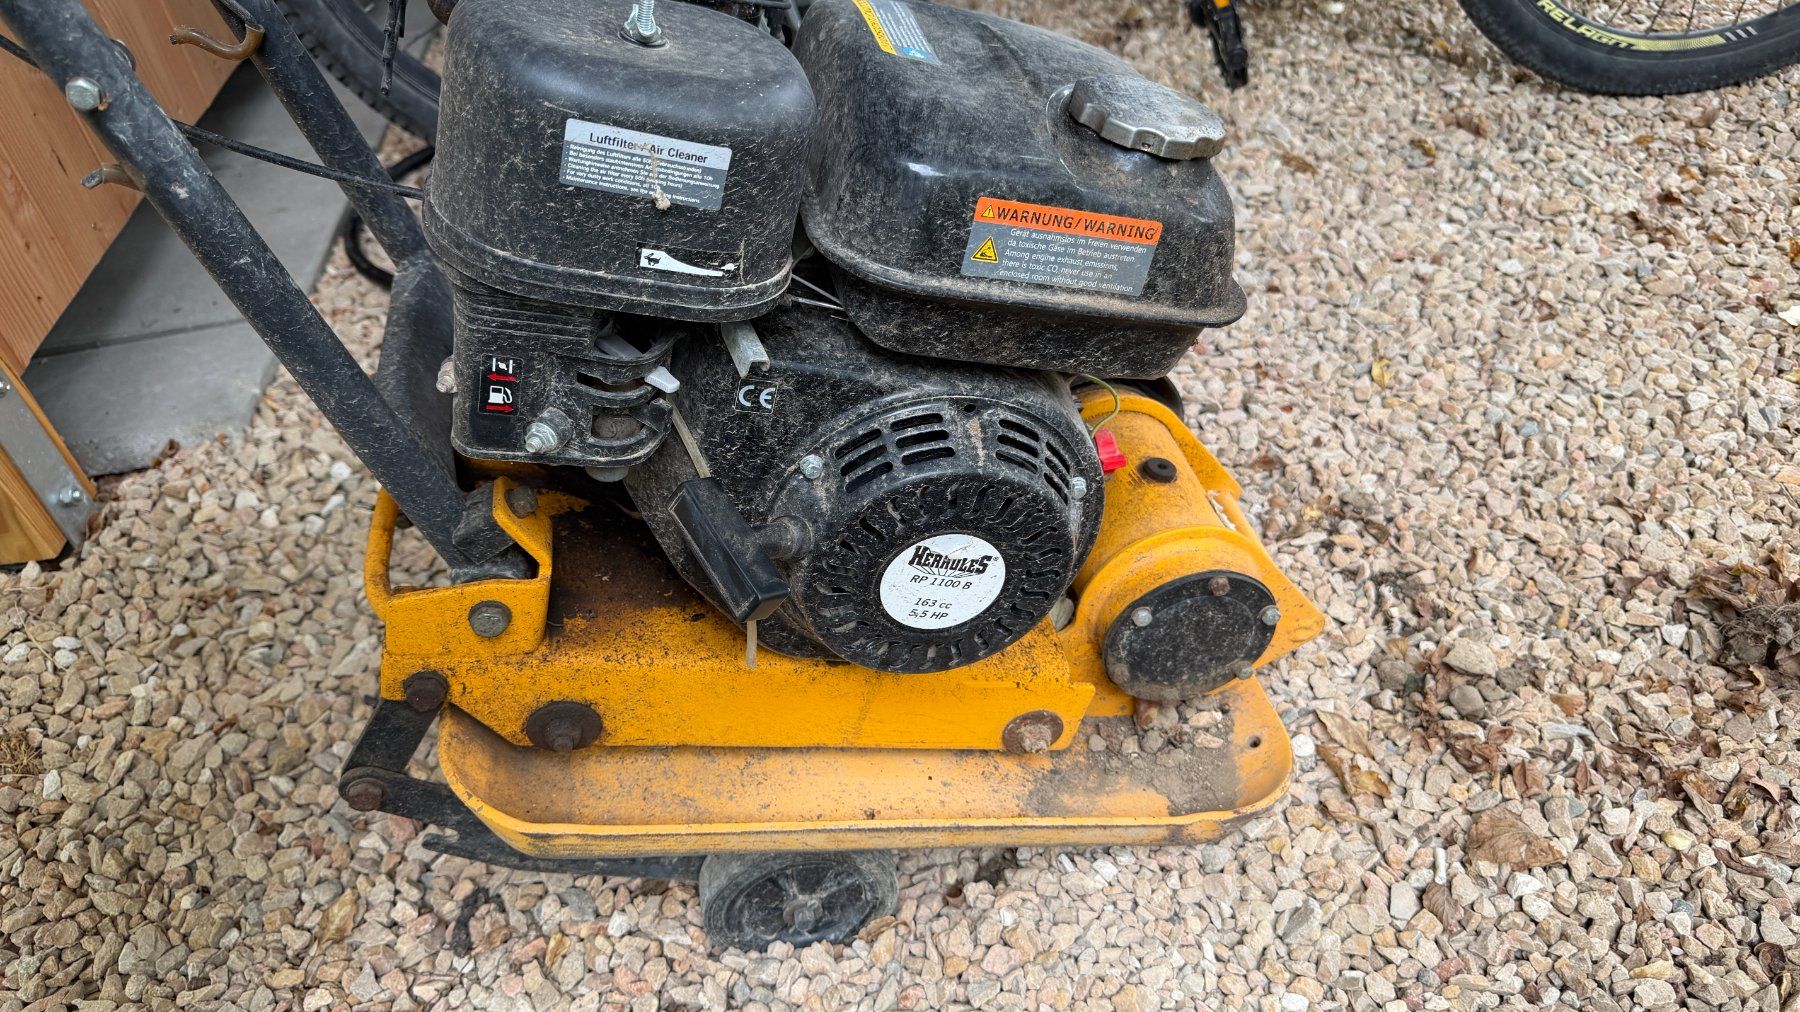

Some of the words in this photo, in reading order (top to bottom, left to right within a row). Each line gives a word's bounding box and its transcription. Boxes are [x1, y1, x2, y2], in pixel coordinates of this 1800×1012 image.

[590, 132, 637, 150] Luftfilter
[650, 144, 664, 155] Air
[668, 147, 708, 164] Cleaner
[568, 163, 590, 172] Cleaning
[1019, 240, 1046, 250] toxische
[1048, 244, 1064, 252] Gase
[1078, 248, 1102, 258] Betrieb
[1031, 232, 1074, 244] ausnahmslos
[1088, 239, 1108, 248] Freien
[1110, 244, 1146, 254] verwenden
[1002, 260, 1020, 268] there
[1028, 263, 1044, 271] toxic
[1004, 249, 1030, 260] Among
[1032, 254, 1056, 262] engine
[1057, 256, 1083, 266] exhaust
[1084, 260, 1118, 272] emissions,
[1000, 270, 1029, 280] enclosed
[1032, 273, 1050, 281] room
[1052, 276, 1078, 285] without
[1078, 280, 1097, 288] good
[1098, 283, 1134, 292] ventilation.
[739, 384, 776, 409] CE
[910, 574, 928, 583] RP
[930, 578, 960, 588] 1100
[962, 582, 972, 590] B
[914, 598, 938, 608] 163
[908, 608, 929, 618] 5,5
[930, 612, 948, 620] HP
